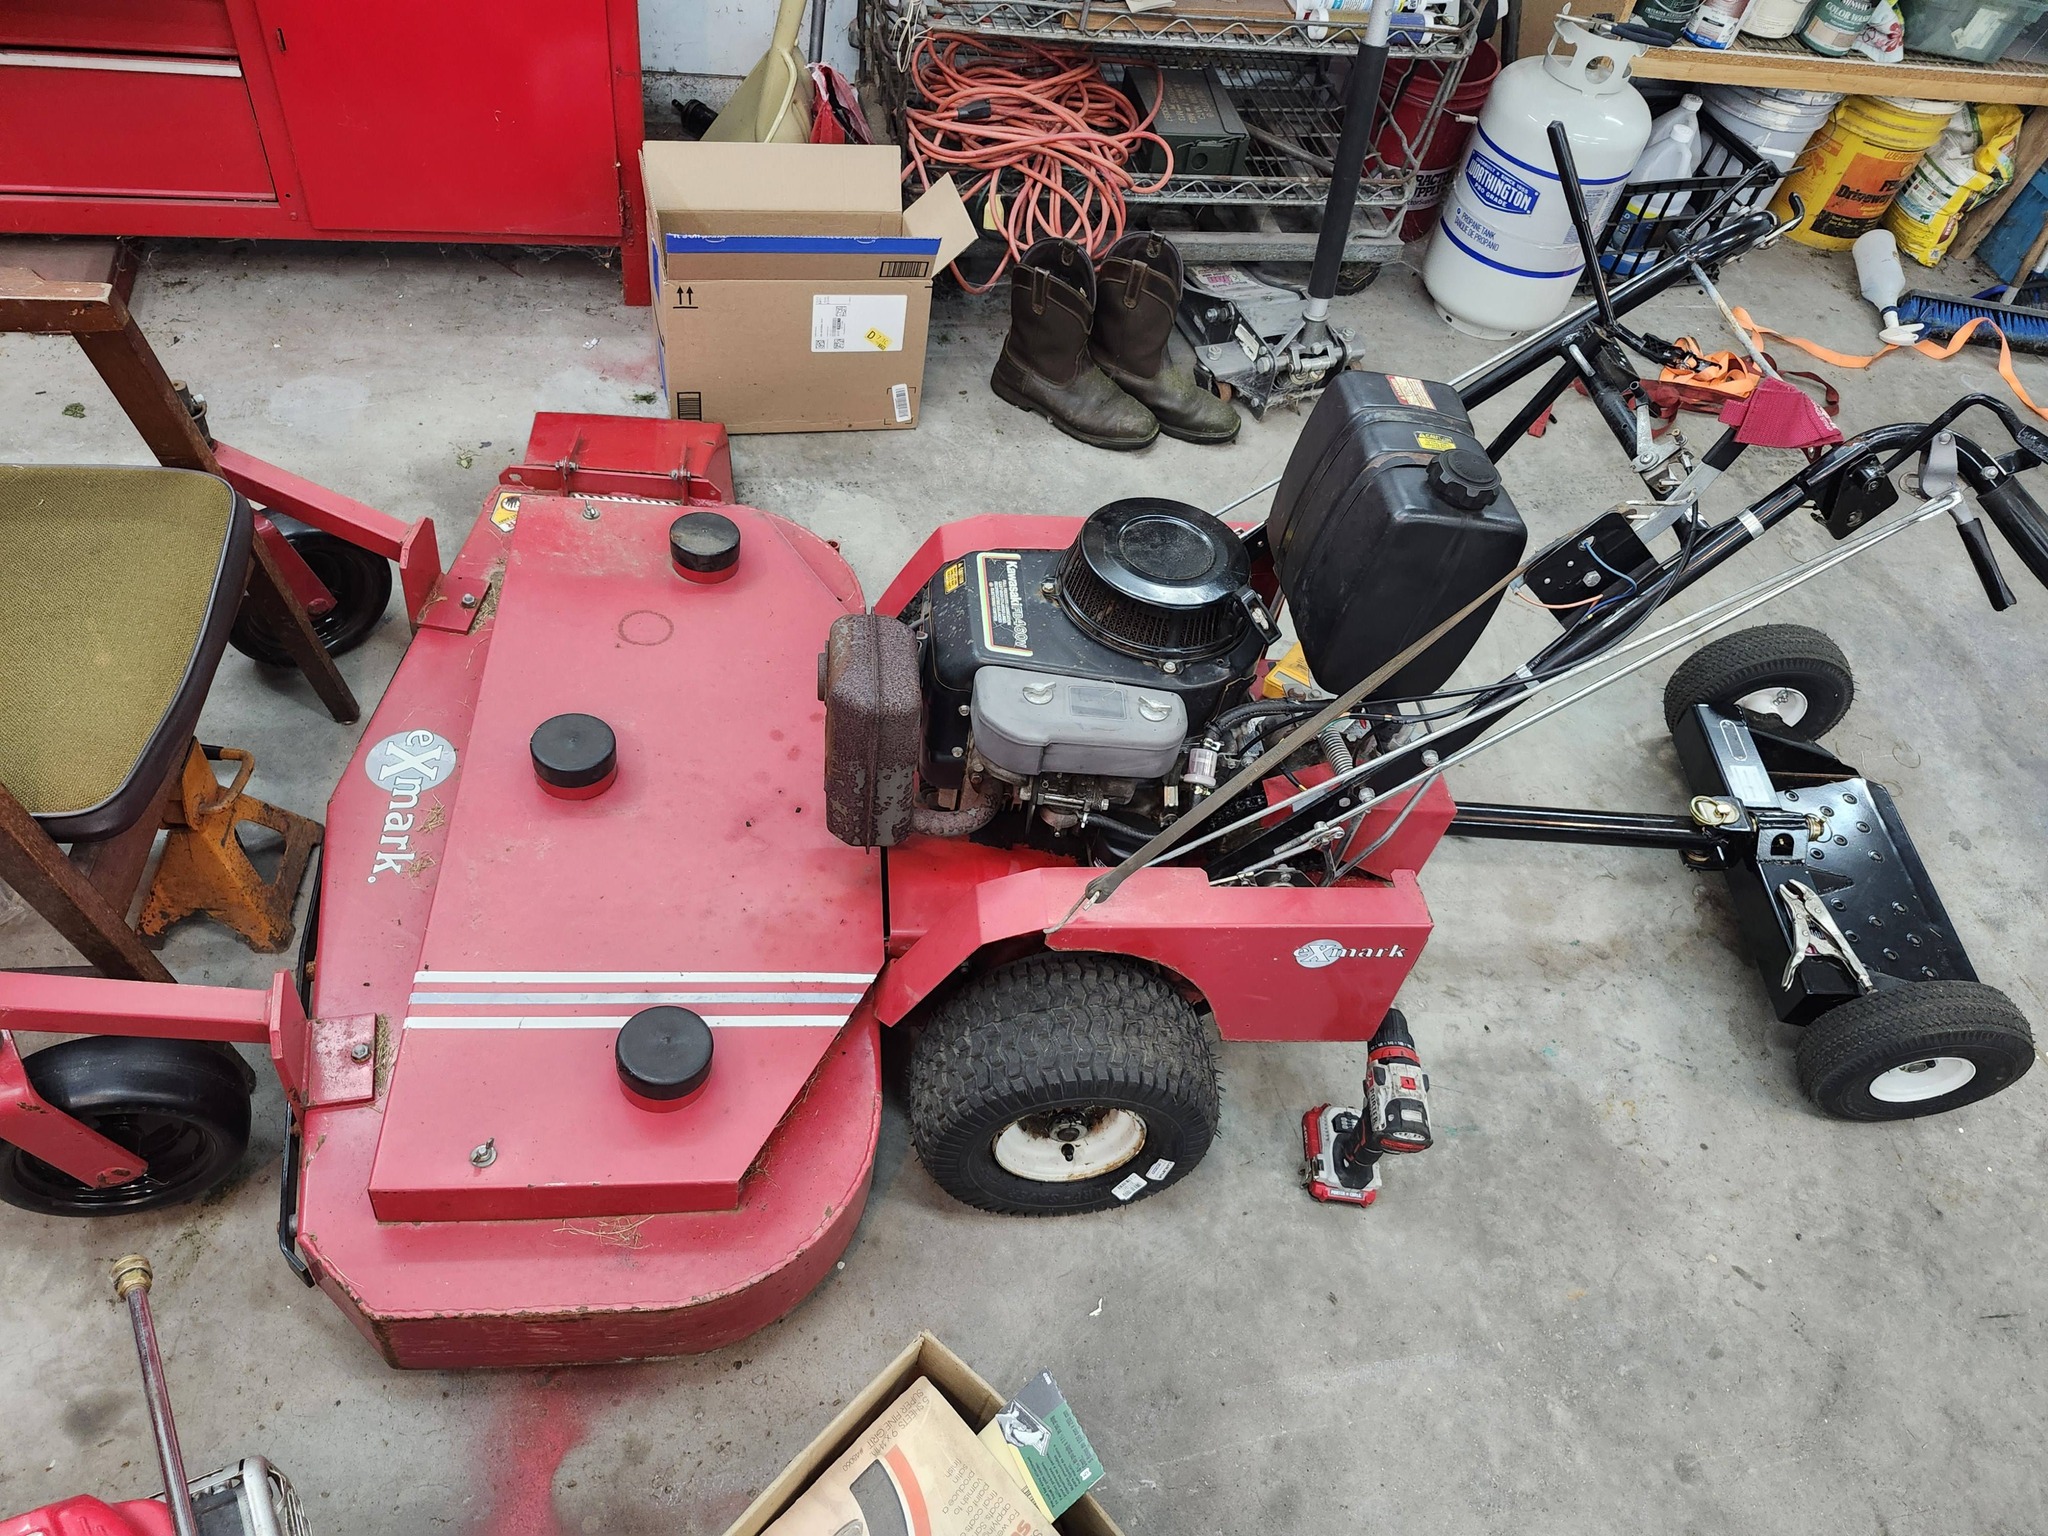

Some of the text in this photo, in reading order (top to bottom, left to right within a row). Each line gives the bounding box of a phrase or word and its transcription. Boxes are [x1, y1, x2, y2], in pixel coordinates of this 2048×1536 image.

[1825, 2, 1851, 19] COLOR
[1467, 158, 1532, 211] WORTHINGTON
[1501, 174, 1517, 187] SINCE
[1474, 182, 1508, 208] PRO GRADE
[1454, 216, 1469, 235] TANQUE
[1473, 233, 1499, 252] PROPANO
[1461, 211, 1497, 240] PROPANE TANK
[1006, 560, 1022, 606] Kawasaki
[373, 729, 445, 874] eXmark
[1293, 944, 1408, 963] eXmark
[1368, 1087, 1380, 1128] PORTER
[900, 1388, 924, 1414] SUPER
[922, 1396, 930, 1405] 5
[884, 1411, 902, 1431] FINE
[898, 1402, 925, 1430] SHEETS
[866, 1428, 885, 1450] GRIT
[891, 1430, 899, 1438] 9
[952, 1464, 968, 1484] satin
[942, 1470, 976, 1514] produce a
[953, 1477, 982, 1515] varnish to
[966, 1482, 990, 1516] paint or
[964, 1490, 998, 1532] final coats
[1008, 1508, 1021, 1526] For
